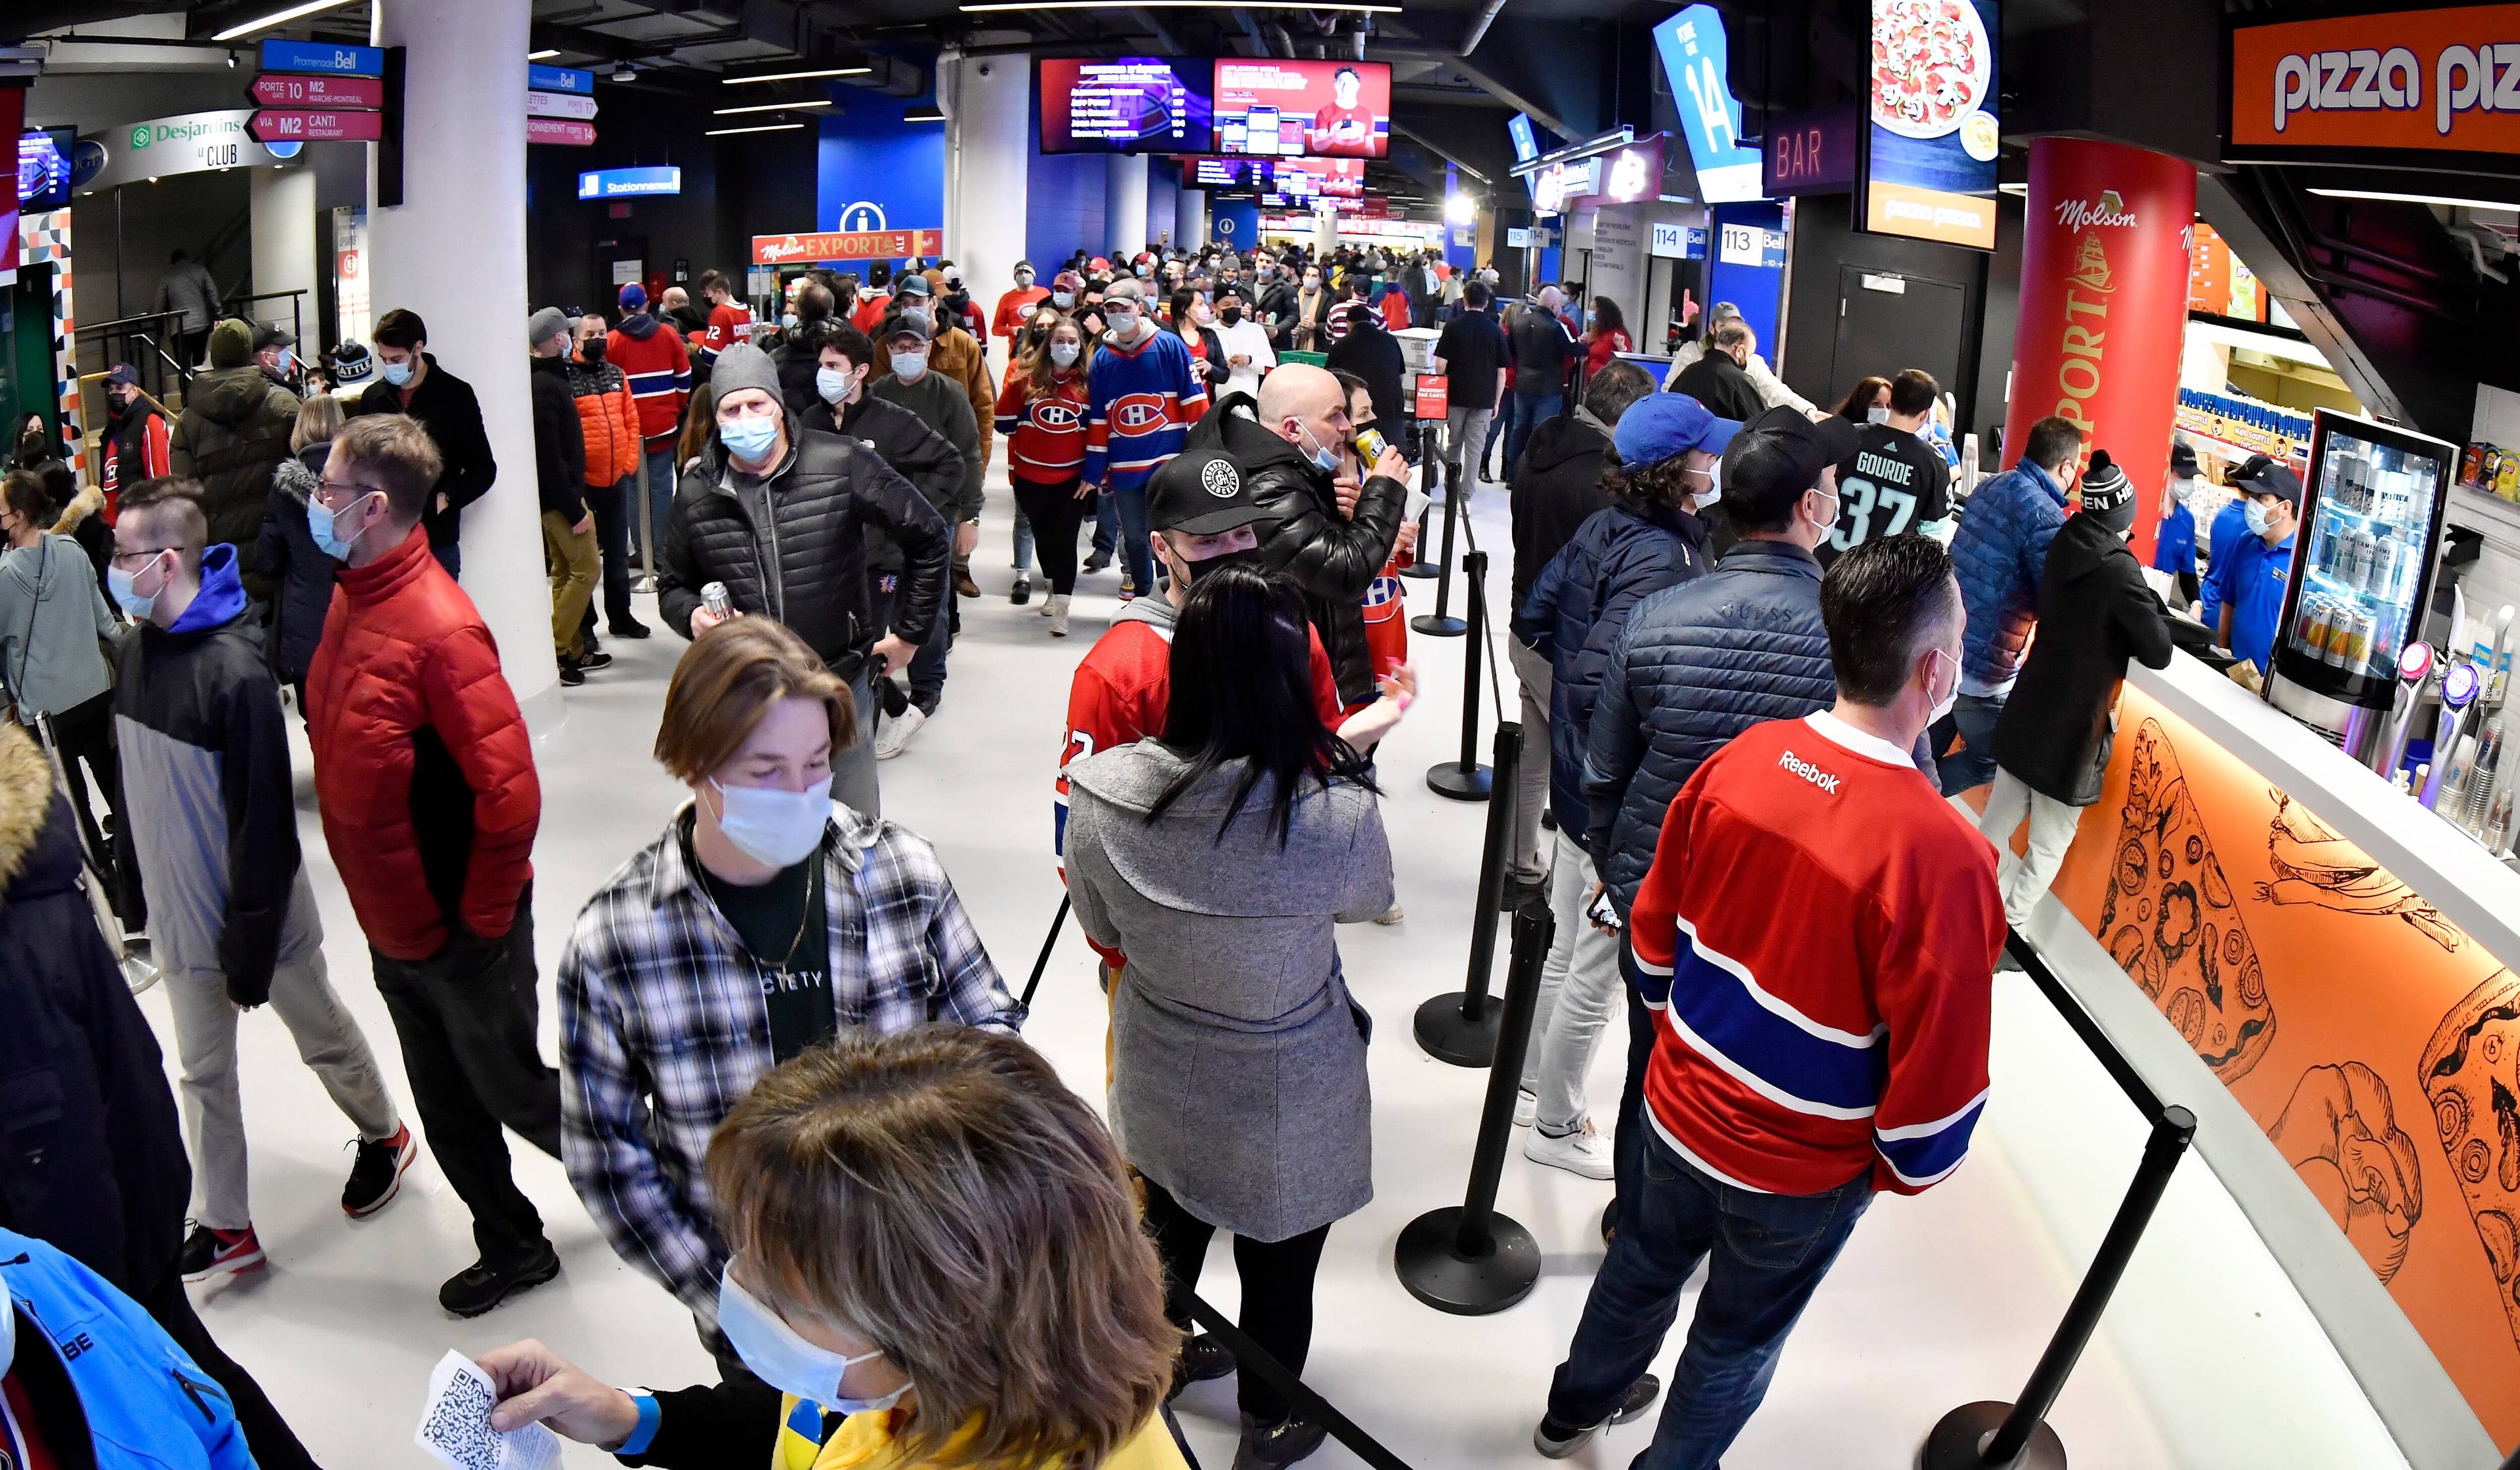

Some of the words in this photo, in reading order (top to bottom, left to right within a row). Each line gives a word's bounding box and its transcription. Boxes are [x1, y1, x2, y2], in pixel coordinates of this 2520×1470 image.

[335, 51, 356, 69] Bell
[260, 81, 284, 92] PORTE
[288, 83, 303, 99] 10
[309, 81, 324, 93] M2
[560, 73, 576, 88] Bell
[157, 118, 240, 142] Desjardins
[260, 117, 273, 127] VIA
[280, 117, 302, 134] M2
[308, 115, 336, 127] CANTI
[584, 127, 593, 140] 14
[207, 144, 237, 166] CLUB
[1776, 130, 1822, 177] BAR
[2055, 199, 2135, 234] Molson
[1509, 232, 1522, 242] 115
[1529, 230, 1543, 240] 114
[1656, 228, 1677, 246] 114
[1687, 232, 1706, 244] Bell
[1725, 230, 1750, 251] 113
[1763, 234, 1784, 249] Bell
[761, 244, 805, 262] Molson
[806, 235, 886, 257] EXPORT
[896, 235, 905, 253] ALE
[1857, 451, 1914, 486] GOURDE
[1830, 476, 1918, 553] 37
[1721, 602, 1792, 623] GUESS
[1778, 749, 1841, 795] Reebok
